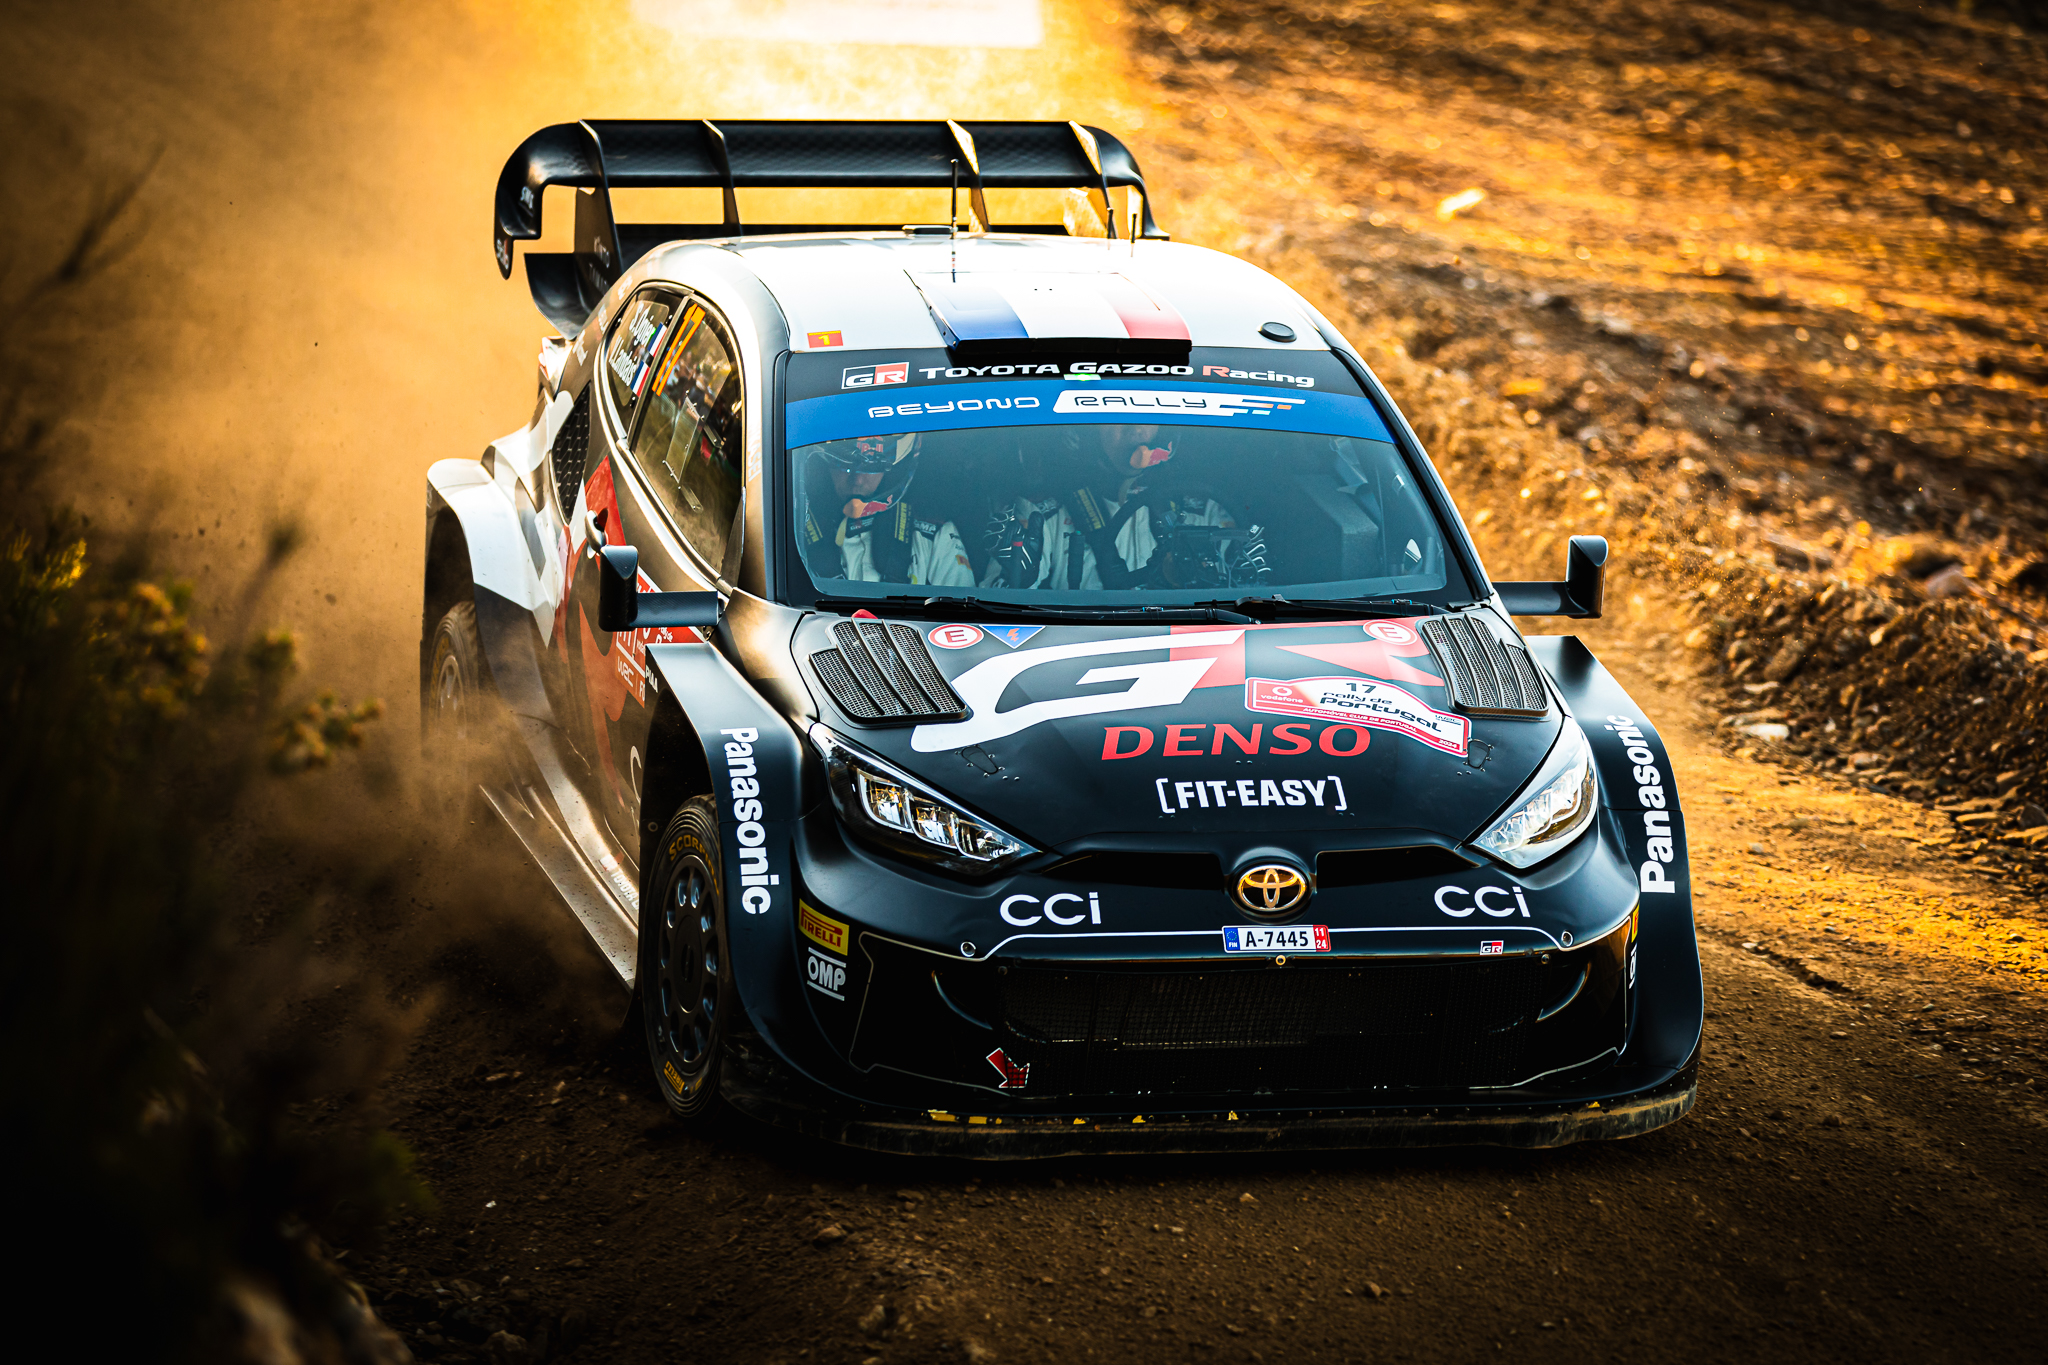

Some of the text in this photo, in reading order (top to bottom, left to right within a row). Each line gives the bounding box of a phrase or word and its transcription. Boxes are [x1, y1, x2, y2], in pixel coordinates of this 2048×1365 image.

[818, 334, 830, 346] 1
[844, 368, 906, 388] GR
[918, 361, 1315, 388] TOYOTA GAZOO Racing
[868, 396, 1207, 419] BEYOND RALLY
[944, 629, 968, 644] E
[1377, 625, 1403, 640] E
[1345, 682, 1377, 694] 17
[1260, 693, 1304, 704] vodafone
[1322, 691, 1393, 705] rally de
[1101, 722, 1372, 762] DENSO
[1604, 714, 1676, 894] Panasonic
[720, 727, 780, 915] Panasonic
[801, 907, 843, 947] PIRELLI
[1314, 927, 1324, 937] 11
[1245, 930, 1309, 948] A-7445
[1316, 939, 1327, 949] 24
[807, 956, 846, 991] OMP
